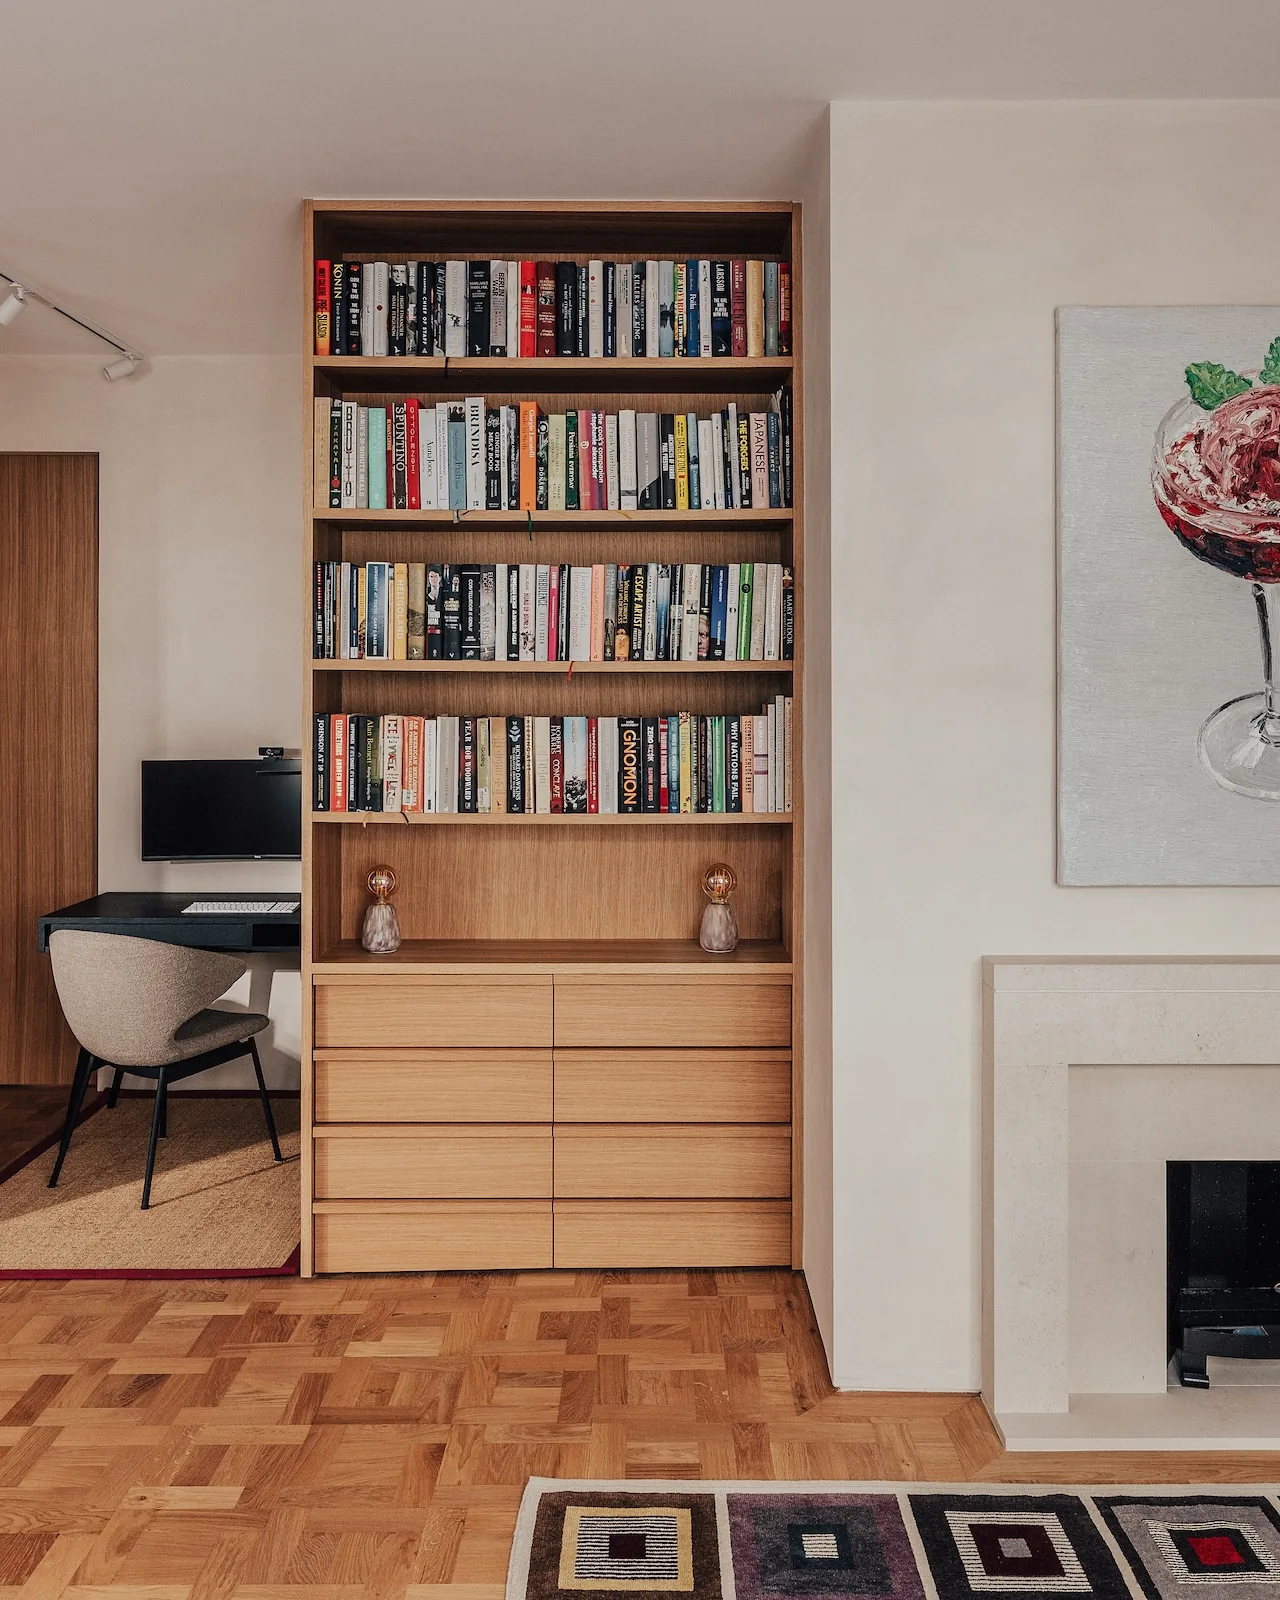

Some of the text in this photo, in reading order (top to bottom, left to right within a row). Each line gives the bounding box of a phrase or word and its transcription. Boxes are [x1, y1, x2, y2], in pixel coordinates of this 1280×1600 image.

[333, 264, 343, 299] KONIN
[715, 264, 725, 292] LARSSON
[689, 293, 697, 310] Poilu
[395, 406, 404, 471] SPUNTINO
[470, 405, 480, 467] BRINDISA
[590, 413, 598, 445] stephanie
[739, 419, 749, 471] THE FORGERS
[677, 437, 685, 459] DANGER
[754, 418, 765, 473] JAPANESE
[455, 461, 463, 480] Fish
[538, 572, 547, 607] TURBULENCE
[635, 576, 644, 602] ESCAPE
[633, 603, 642, 627] ARTIST
[317, 719, 325, 752] JOHNSON
[681, 727, 689, 764] Hibiscus
[318, 754, 324, 763] AT
[318, 764, 324, 772] 10
[623, 729, 637, 804] GNOMON
